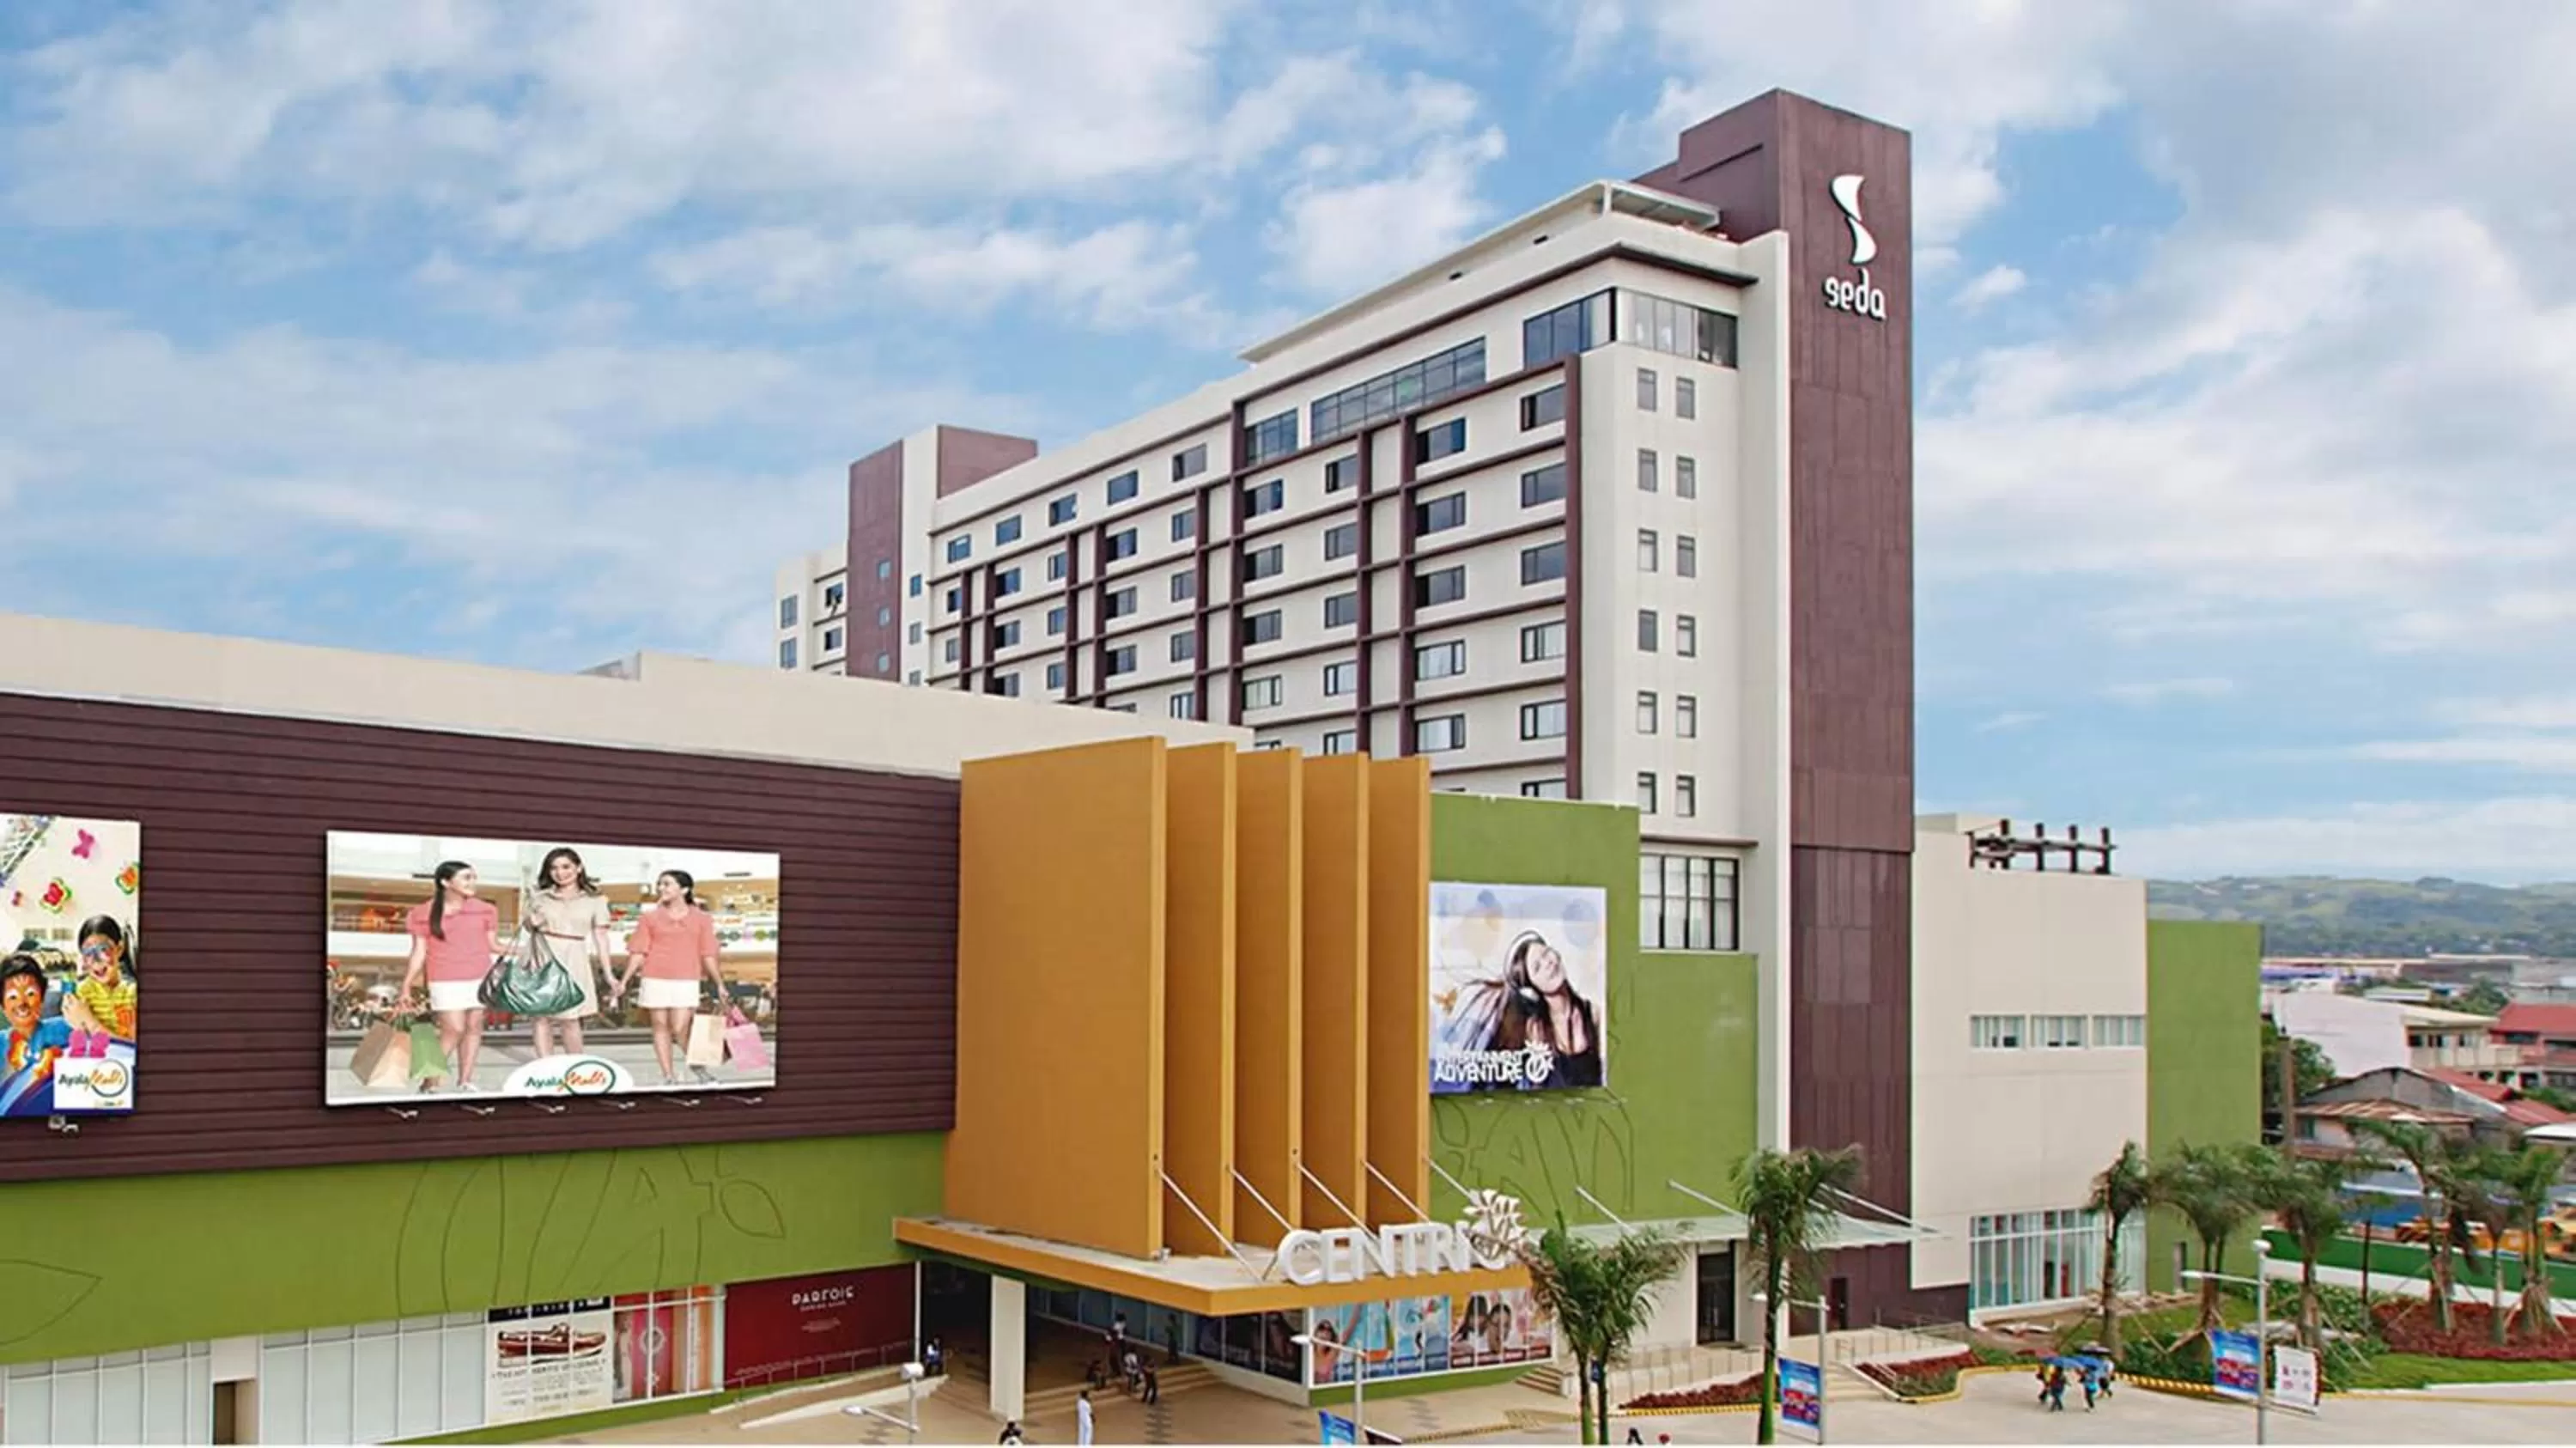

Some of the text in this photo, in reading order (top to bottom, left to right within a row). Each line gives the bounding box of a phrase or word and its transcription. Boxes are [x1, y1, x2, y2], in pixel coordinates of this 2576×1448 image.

[1823, 266, 1886, 321] seda
[524, 1075, 566, 1089] Ayala
[1435, 1061, 1523, 1083] ADVENTURE
